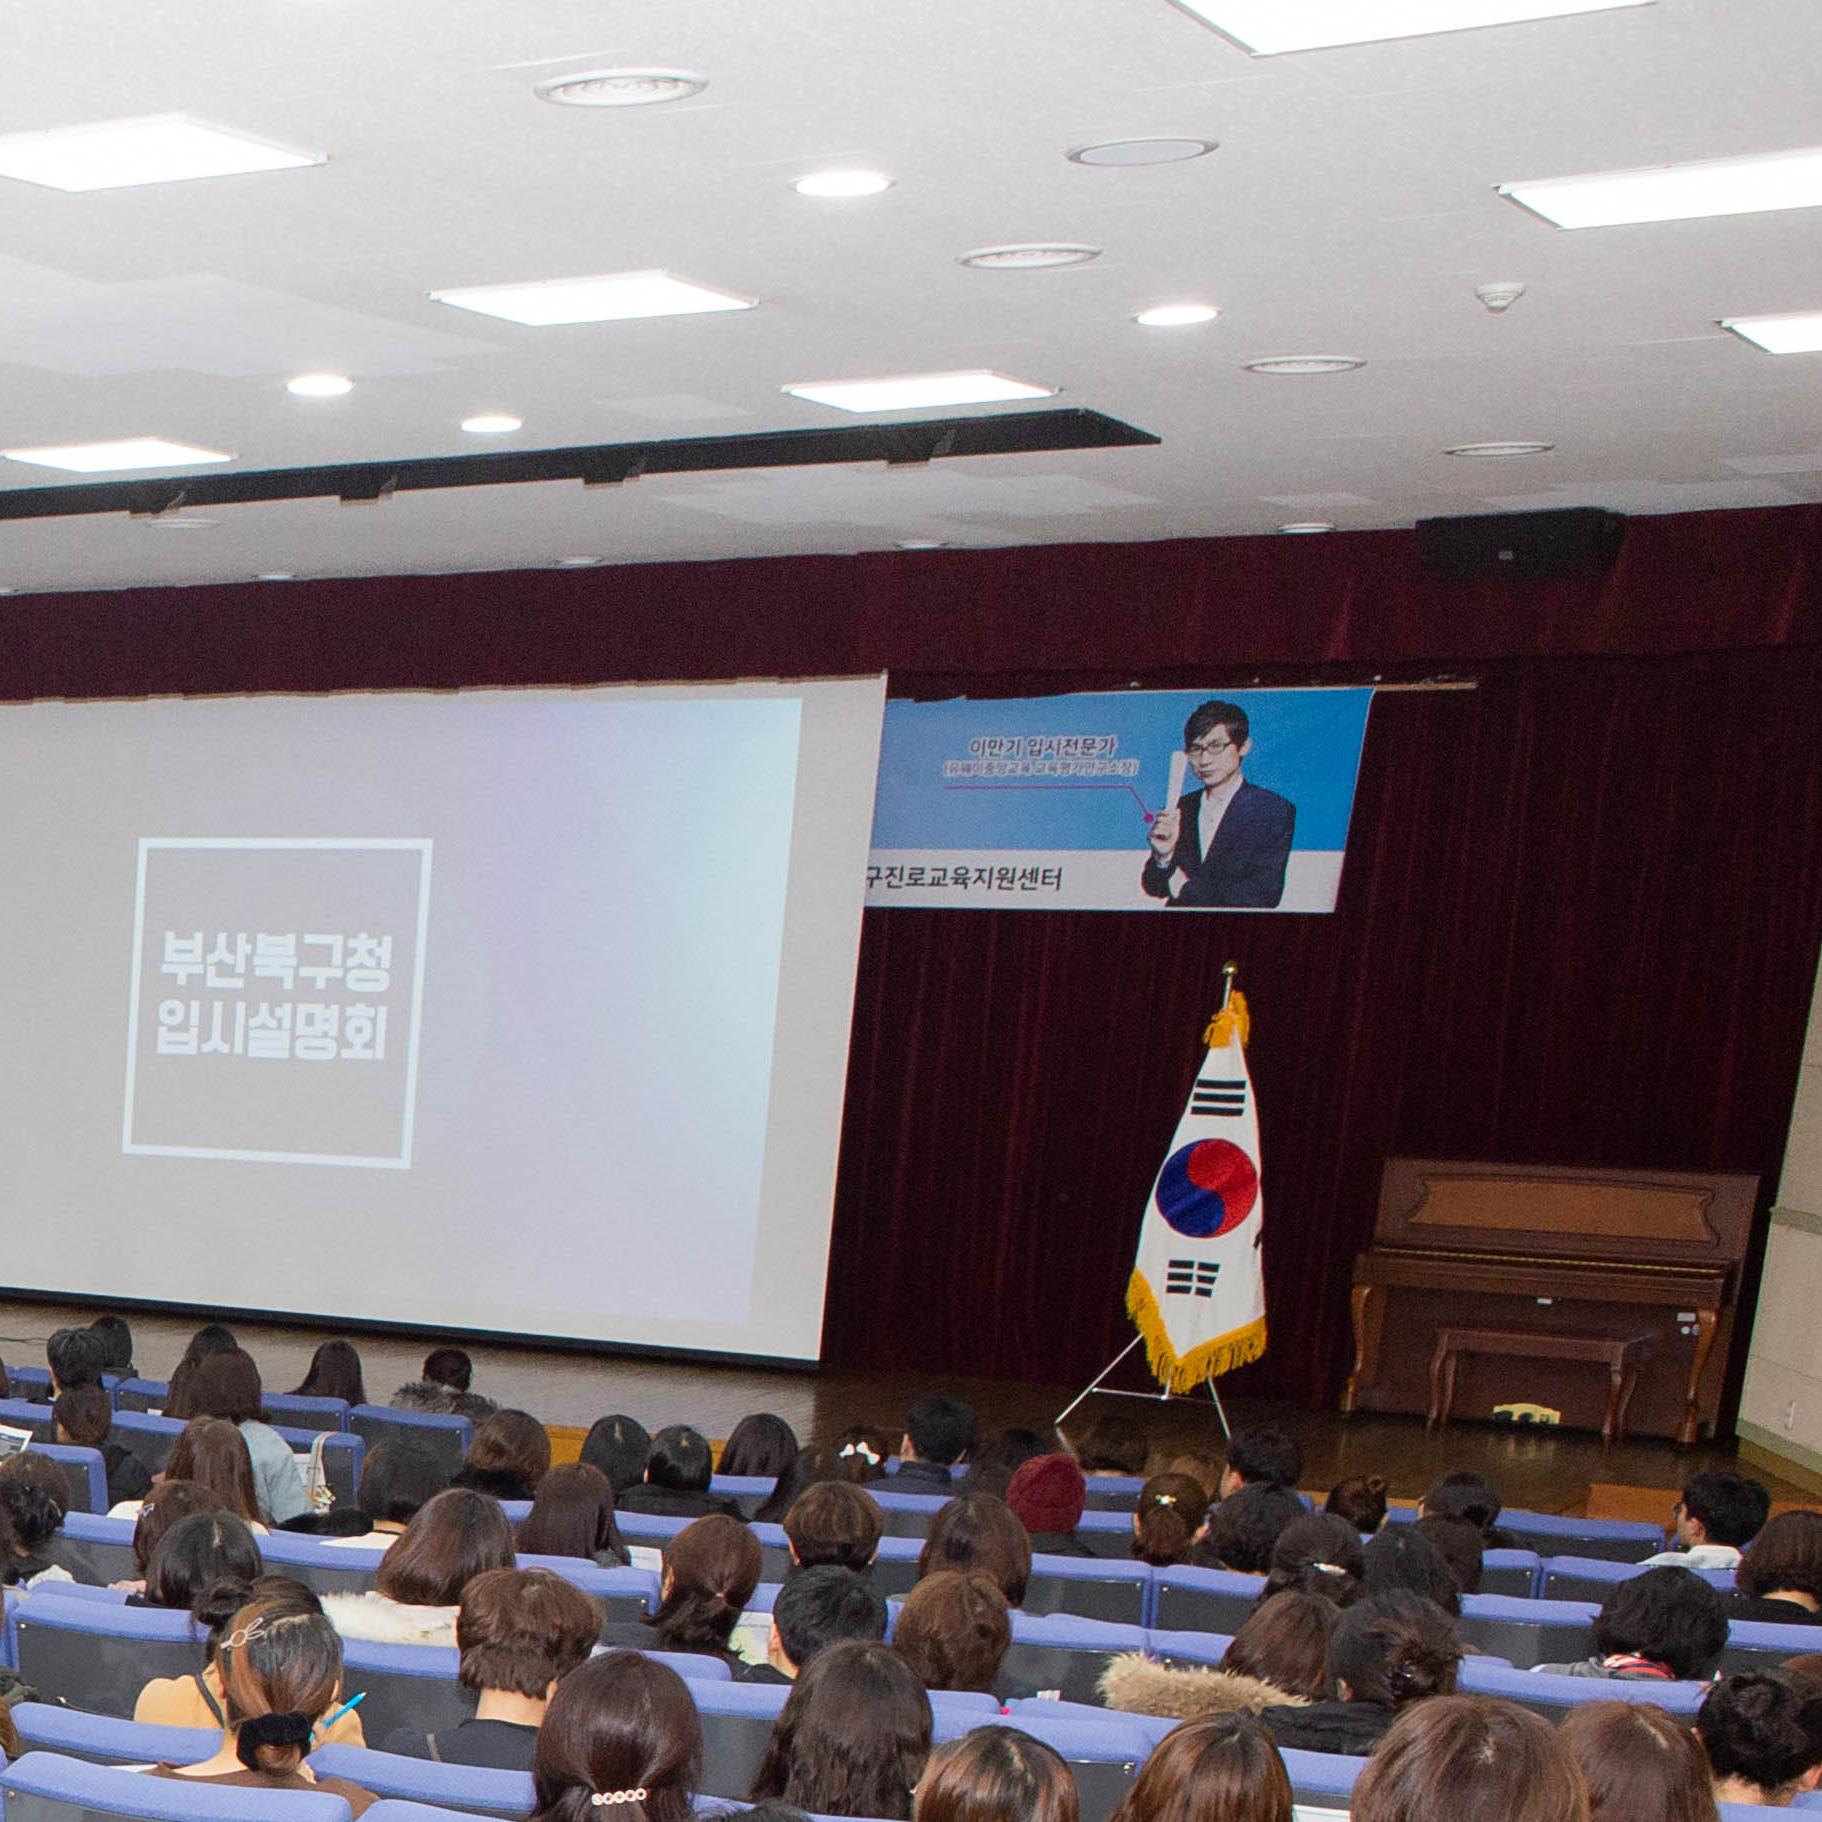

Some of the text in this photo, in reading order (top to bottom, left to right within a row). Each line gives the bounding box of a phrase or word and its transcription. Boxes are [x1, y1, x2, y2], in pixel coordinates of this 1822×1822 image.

[970, 736, 1117, 757] 이만기 입시전문가
[160, 930, 393, 992] 부산북구청
[156, 998, 389, 1062] 입시설명회
